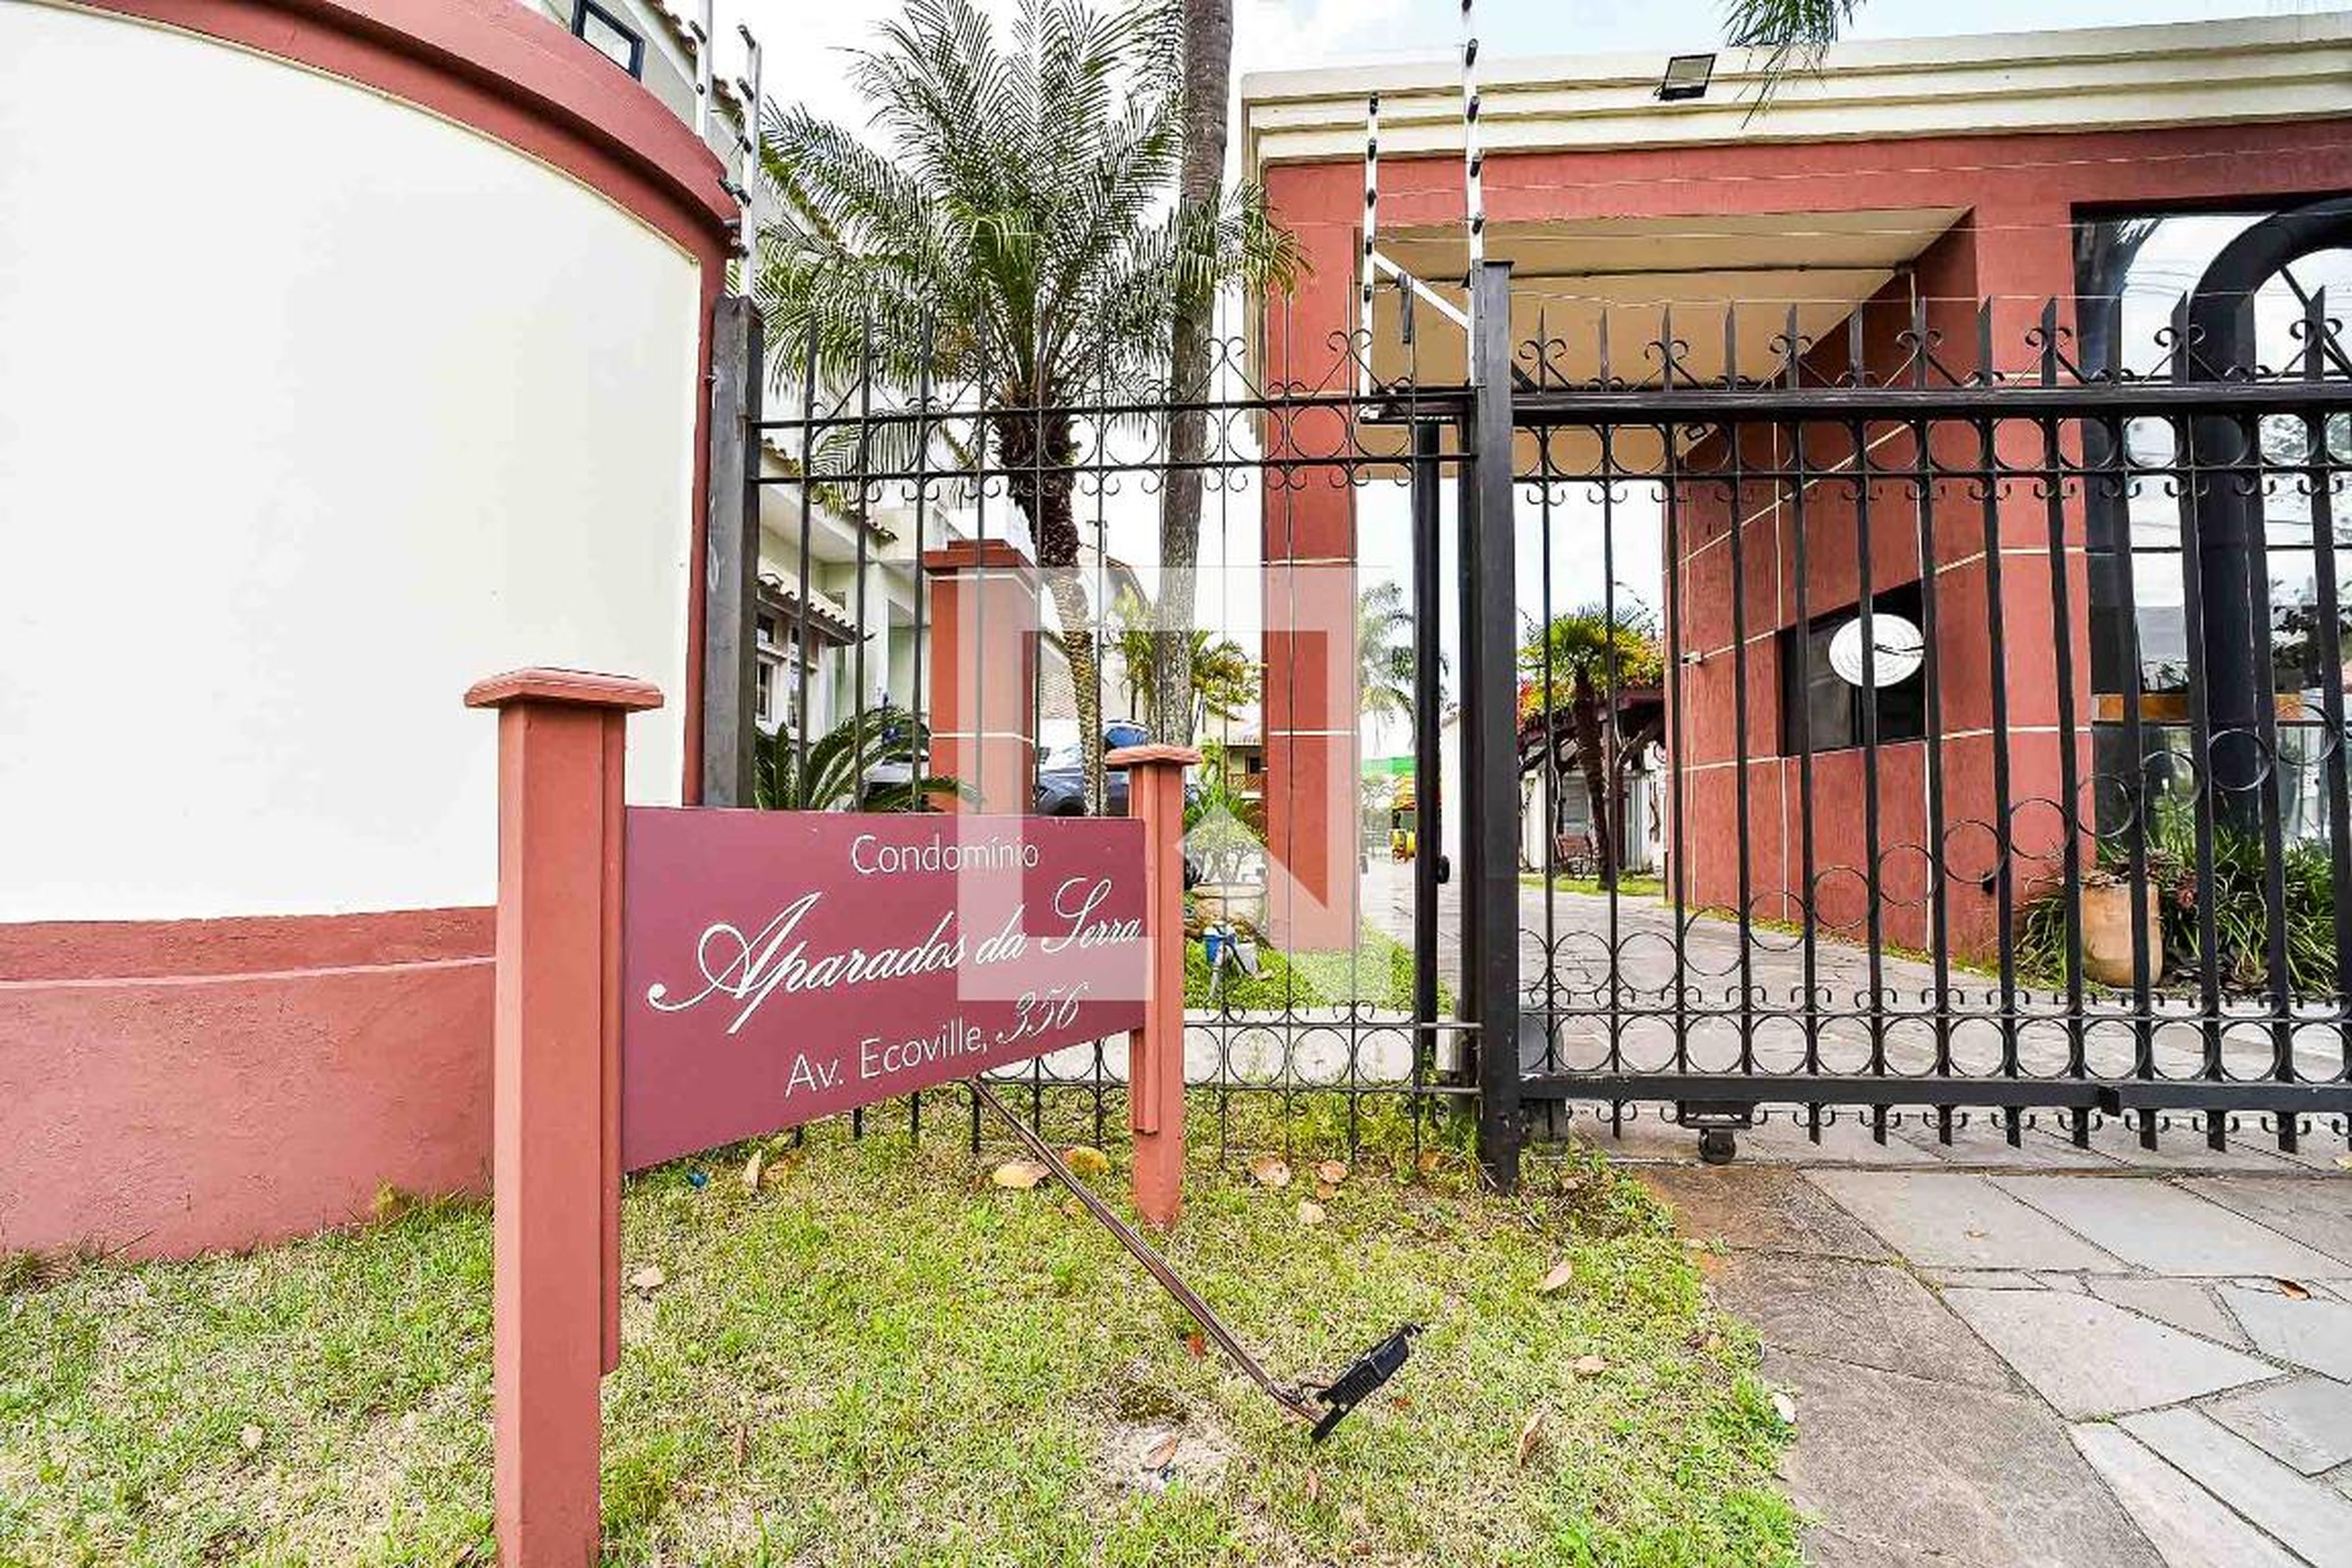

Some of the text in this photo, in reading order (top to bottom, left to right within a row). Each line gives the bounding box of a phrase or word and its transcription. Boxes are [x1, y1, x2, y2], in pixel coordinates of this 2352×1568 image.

[851, 834, 1039, 874] Condomínio
[648, 878, 1142, 1034] Aparados da Serra
[785, 982, 1090, 1098] Av. Ecoville, 356
